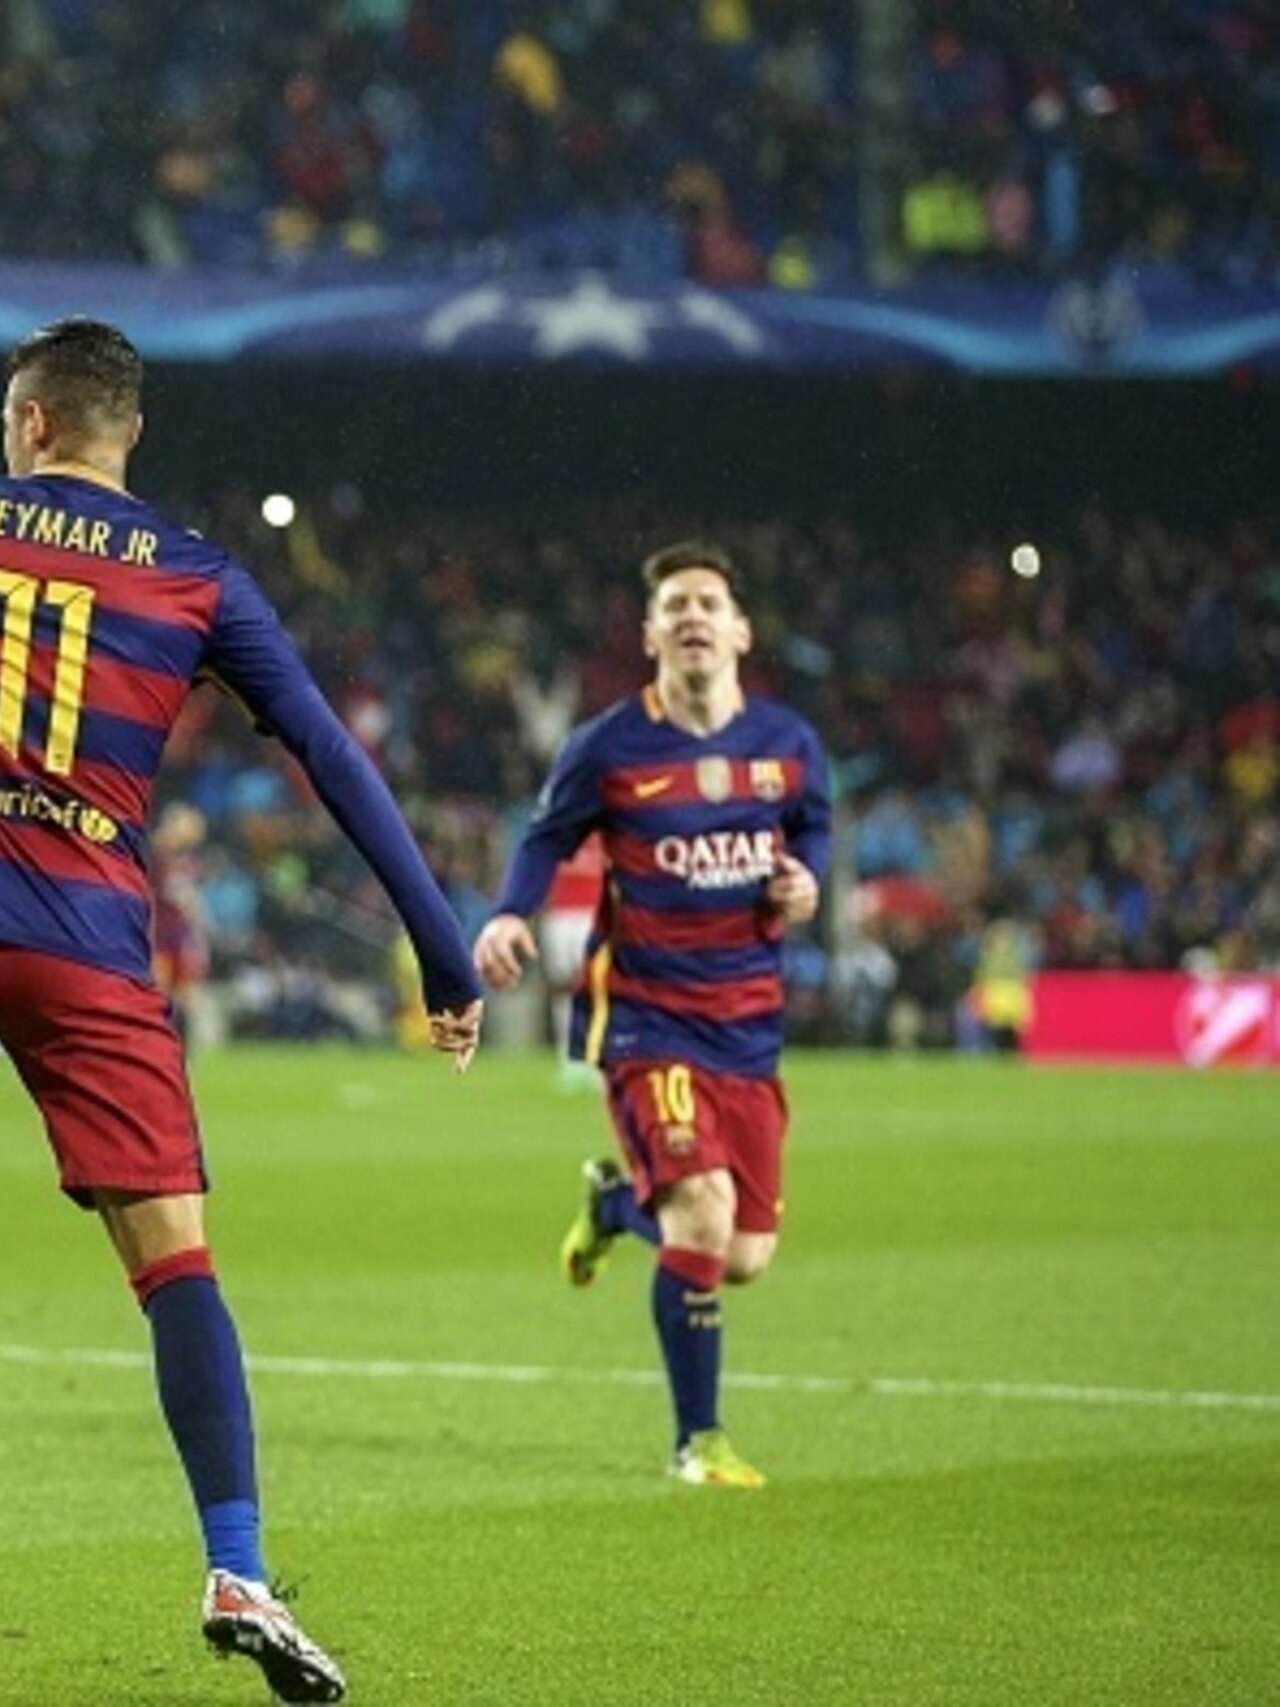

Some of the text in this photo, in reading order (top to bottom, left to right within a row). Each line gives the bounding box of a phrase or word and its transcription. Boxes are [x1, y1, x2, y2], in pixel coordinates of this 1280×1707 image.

[120, 527, 158, 566] JR
[654, 831, 773, 877] QATAR
[647, 1064, 695, 1122] 10
